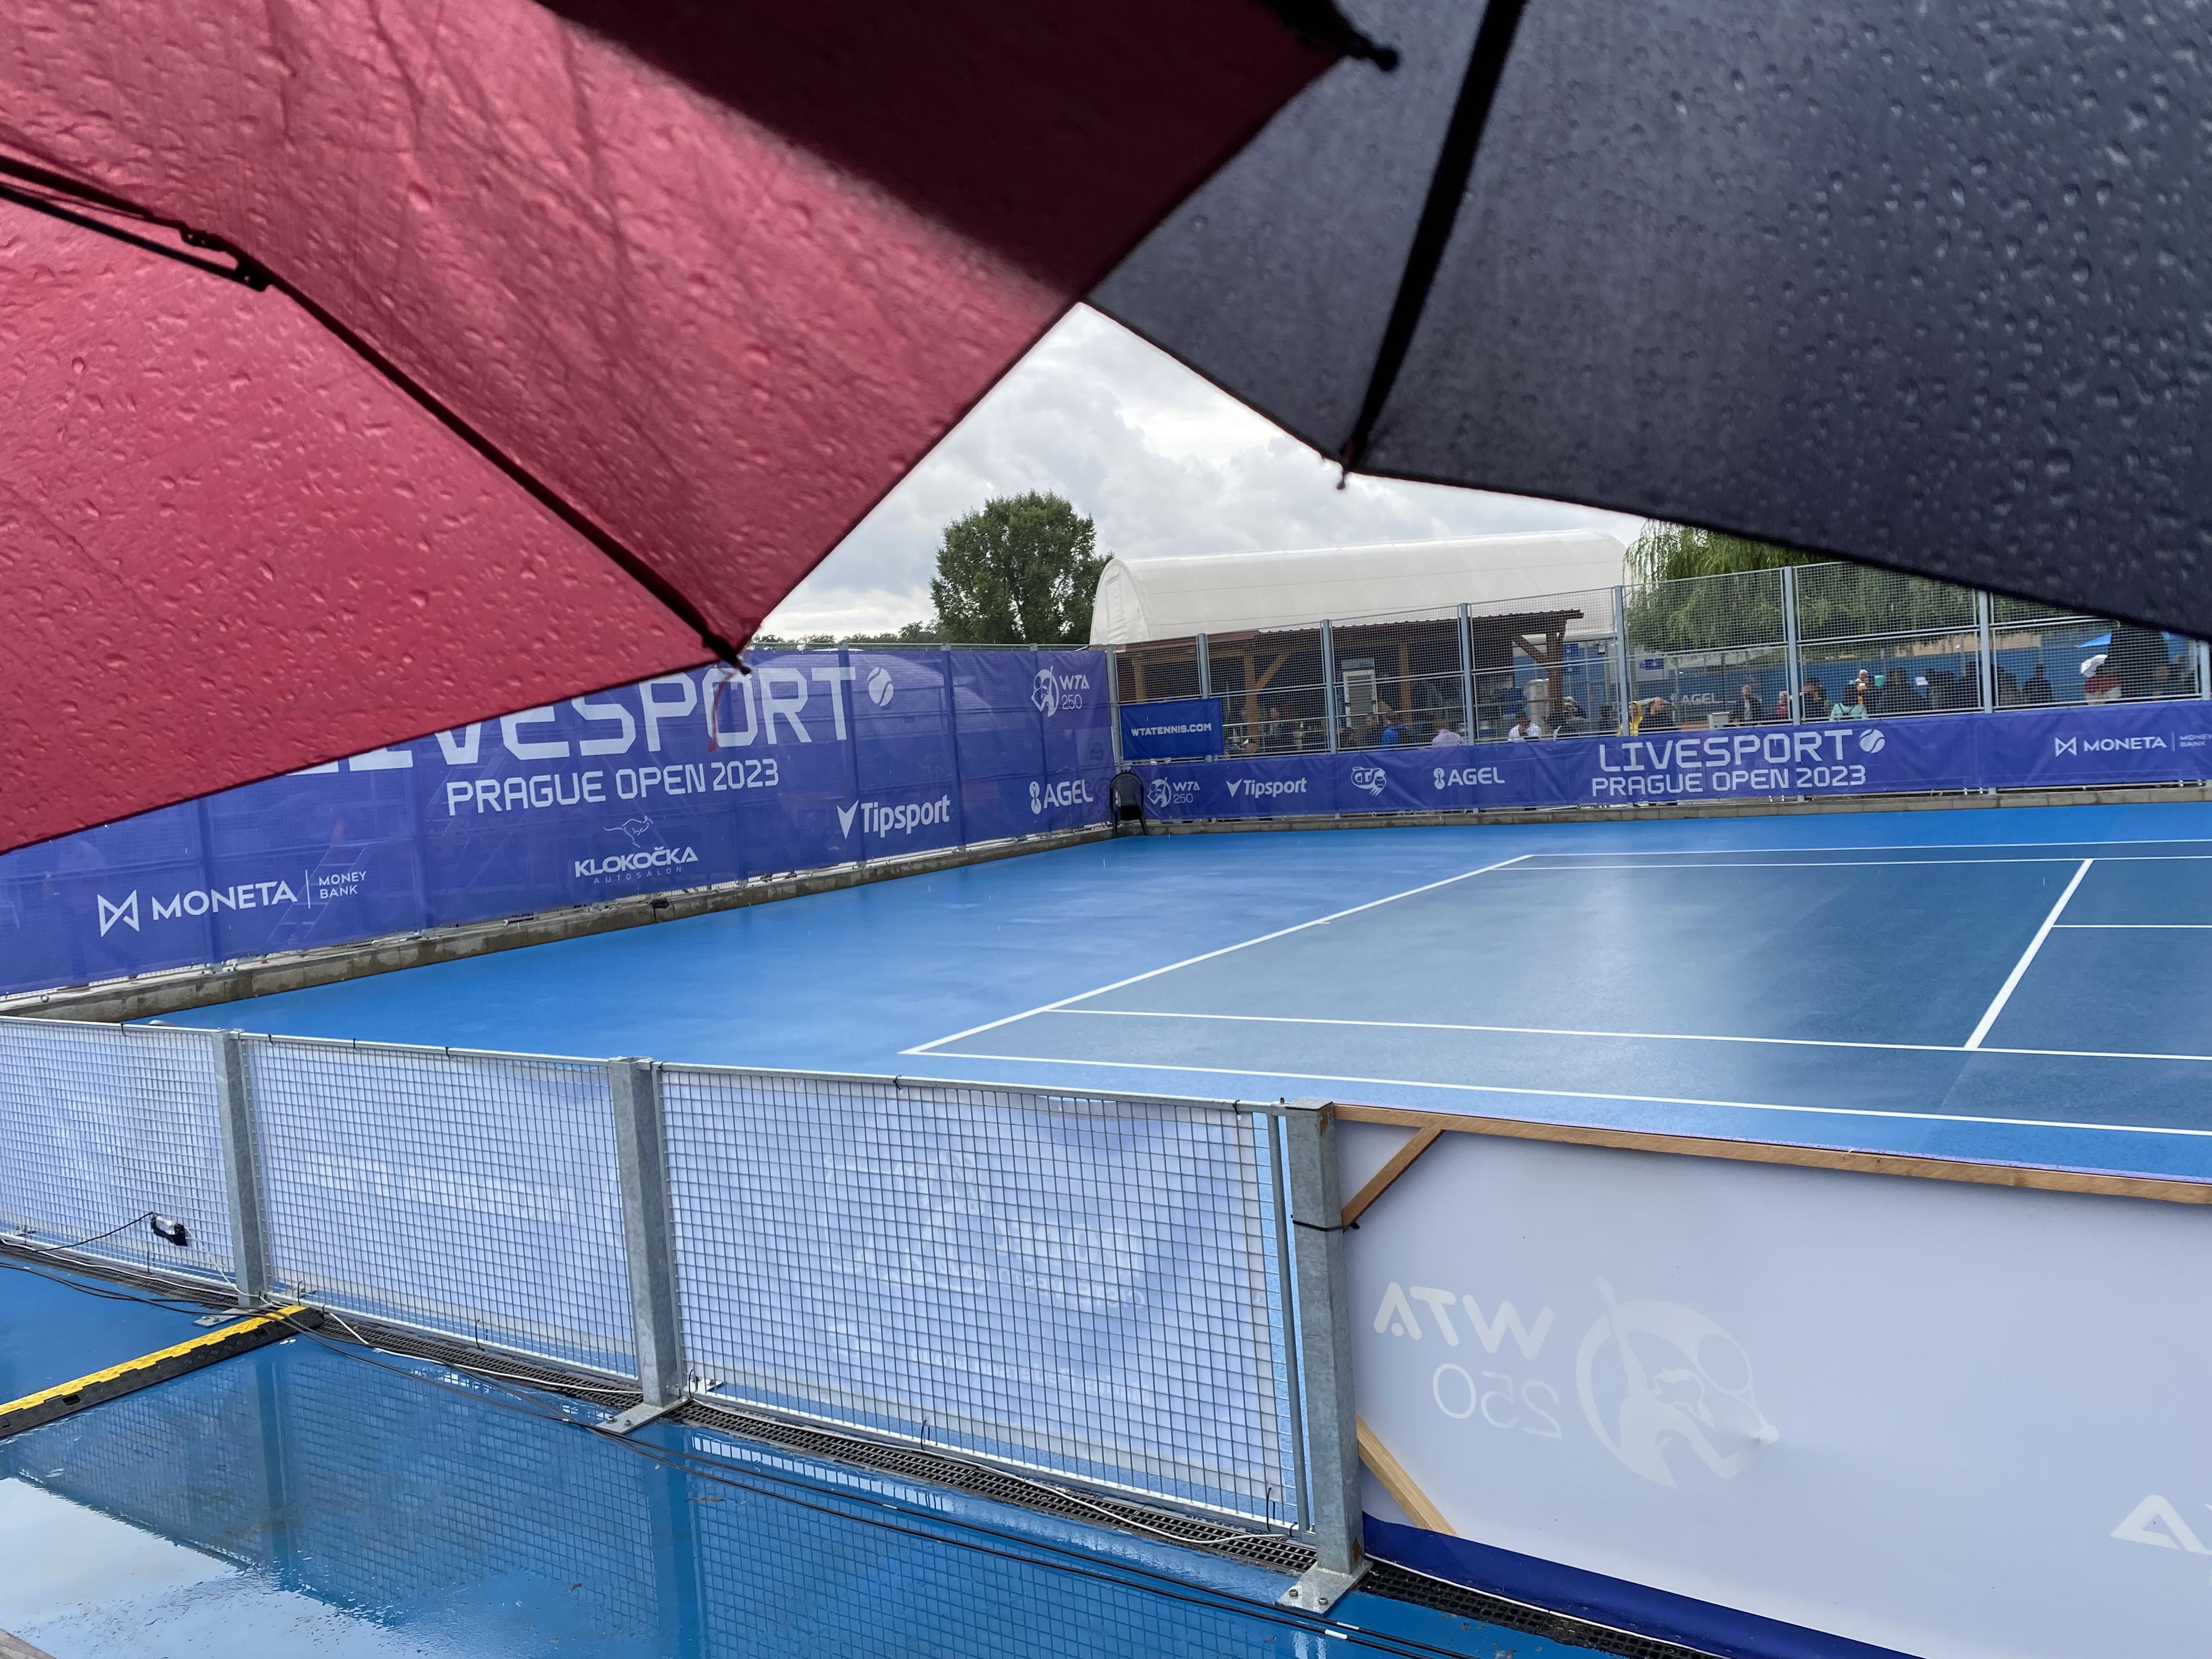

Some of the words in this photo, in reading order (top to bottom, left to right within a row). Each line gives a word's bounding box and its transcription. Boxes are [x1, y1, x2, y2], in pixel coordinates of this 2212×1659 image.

[1059, 675, 1089, 690] WTA
[1061, 694, 1082, 709] 250
[286, 667, 855, 775] VESPORT
[1131, 723, 1212, 737] WTATENNIS.COM
[1599, 729, 1853, 772] LIVESPORT
[2083, 736, 2168, 752] MONETA
[1173, 781, 1200, 791] WTA
[1447, 766, 1505, 786] AGEL
[1592, 773, 1704, 797] PRAGUE
[1713, 768, 1791, 791] OPEN
[1796, 764, 1866, 788] 2023
[446, 770, 606, 816] PRAGUE
[615, 763, 706, 799] OPEN
[712, 758, 780, 792] 2023
[1044, 779, 1093, 809] AGEL
[1244, 777, 1307, 799] Tipsport
[1173, 793, 1193, 804] 250
[860, 794, 951, 838] Tipsport
[575, 846, 699, 878] KLOKOČKA
[319, 870, 367, 886] MONEY
[593, 866, 682, 885] AUTOSALON
[152, 880, 299, 921] MONETA
[320, 884, 358, 900] BANK
